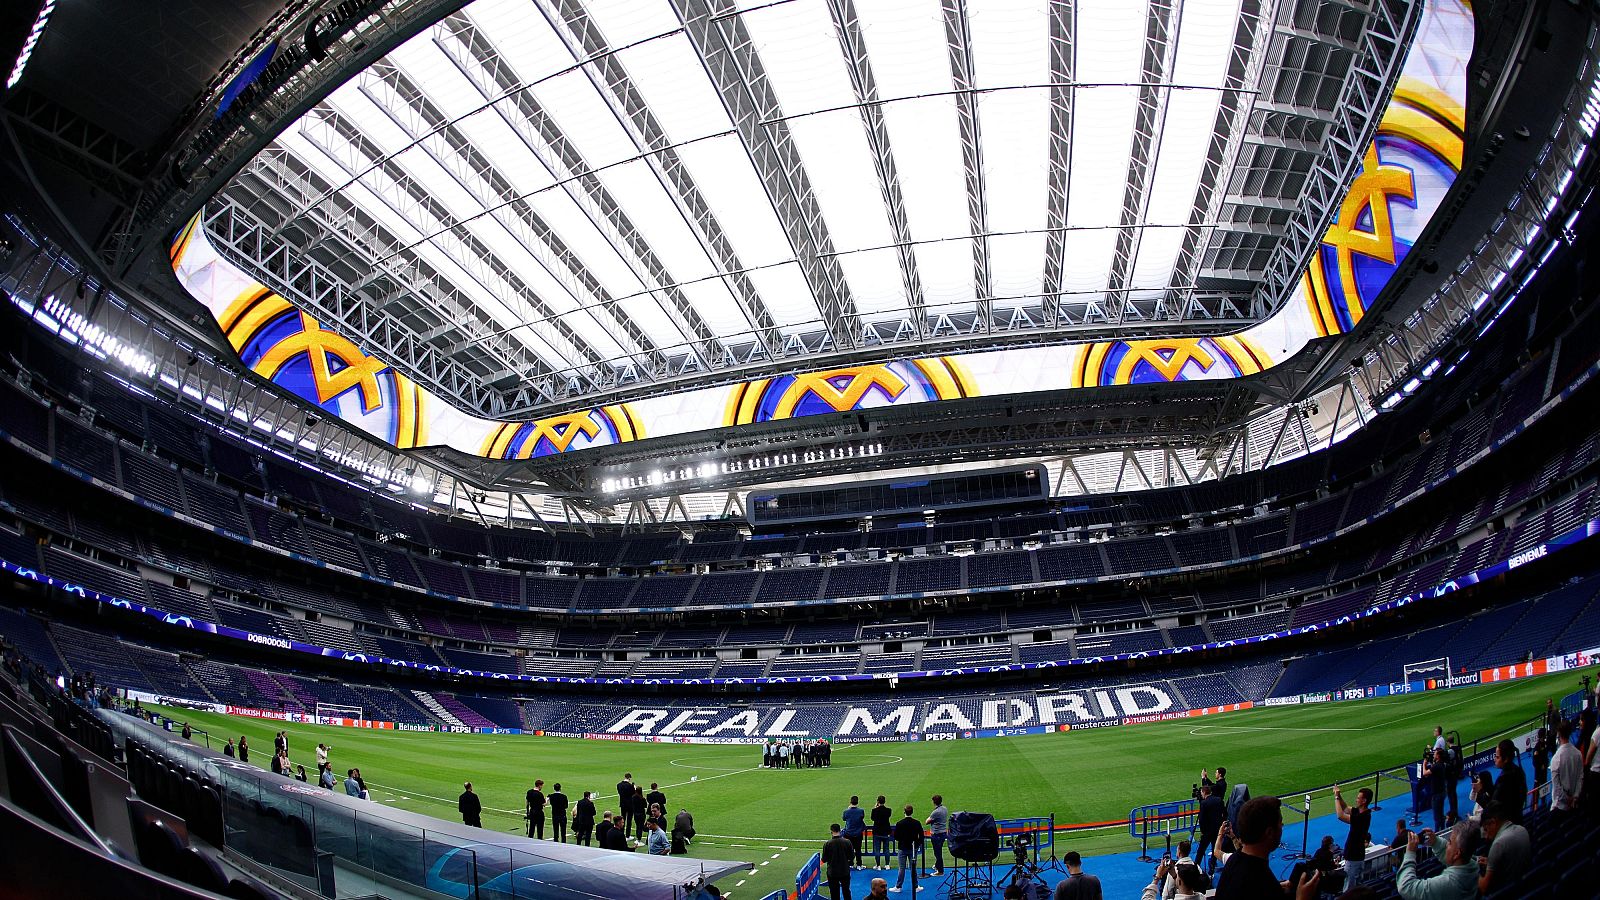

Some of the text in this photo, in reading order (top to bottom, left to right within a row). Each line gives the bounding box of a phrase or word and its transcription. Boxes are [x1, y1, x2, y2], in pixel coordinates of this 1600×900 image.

[1508, 544, 1547, 569] BIENVENUE
[1563, 651, 1588, 669] FedEx
[1344, 688, 1364, 700] PEPSI
[235, 707, 287, 720] TURKISH AIRLINES
[606, 685, 1172, 737] REAL MADRID
[291, 713, 309, 723] FedEx
[320, 716, 337, 726] FedEx
[1133, 711, 1190, 724] TURKISH AIRLINES
[398, 722, 429, 732] Heineken
[450, 725, 471, 733] PEPSI
[1071, 719, 1119, 730] mastercard
[545, 730, 581, 739] mastercard
[925, 732, 957, 741] PEPSI
[1006, 728, 1027, 736] PS5
[854, 735, 881, 743] CHAMPIONS
[1463, 755, 1489, 770] HAMPIONS
